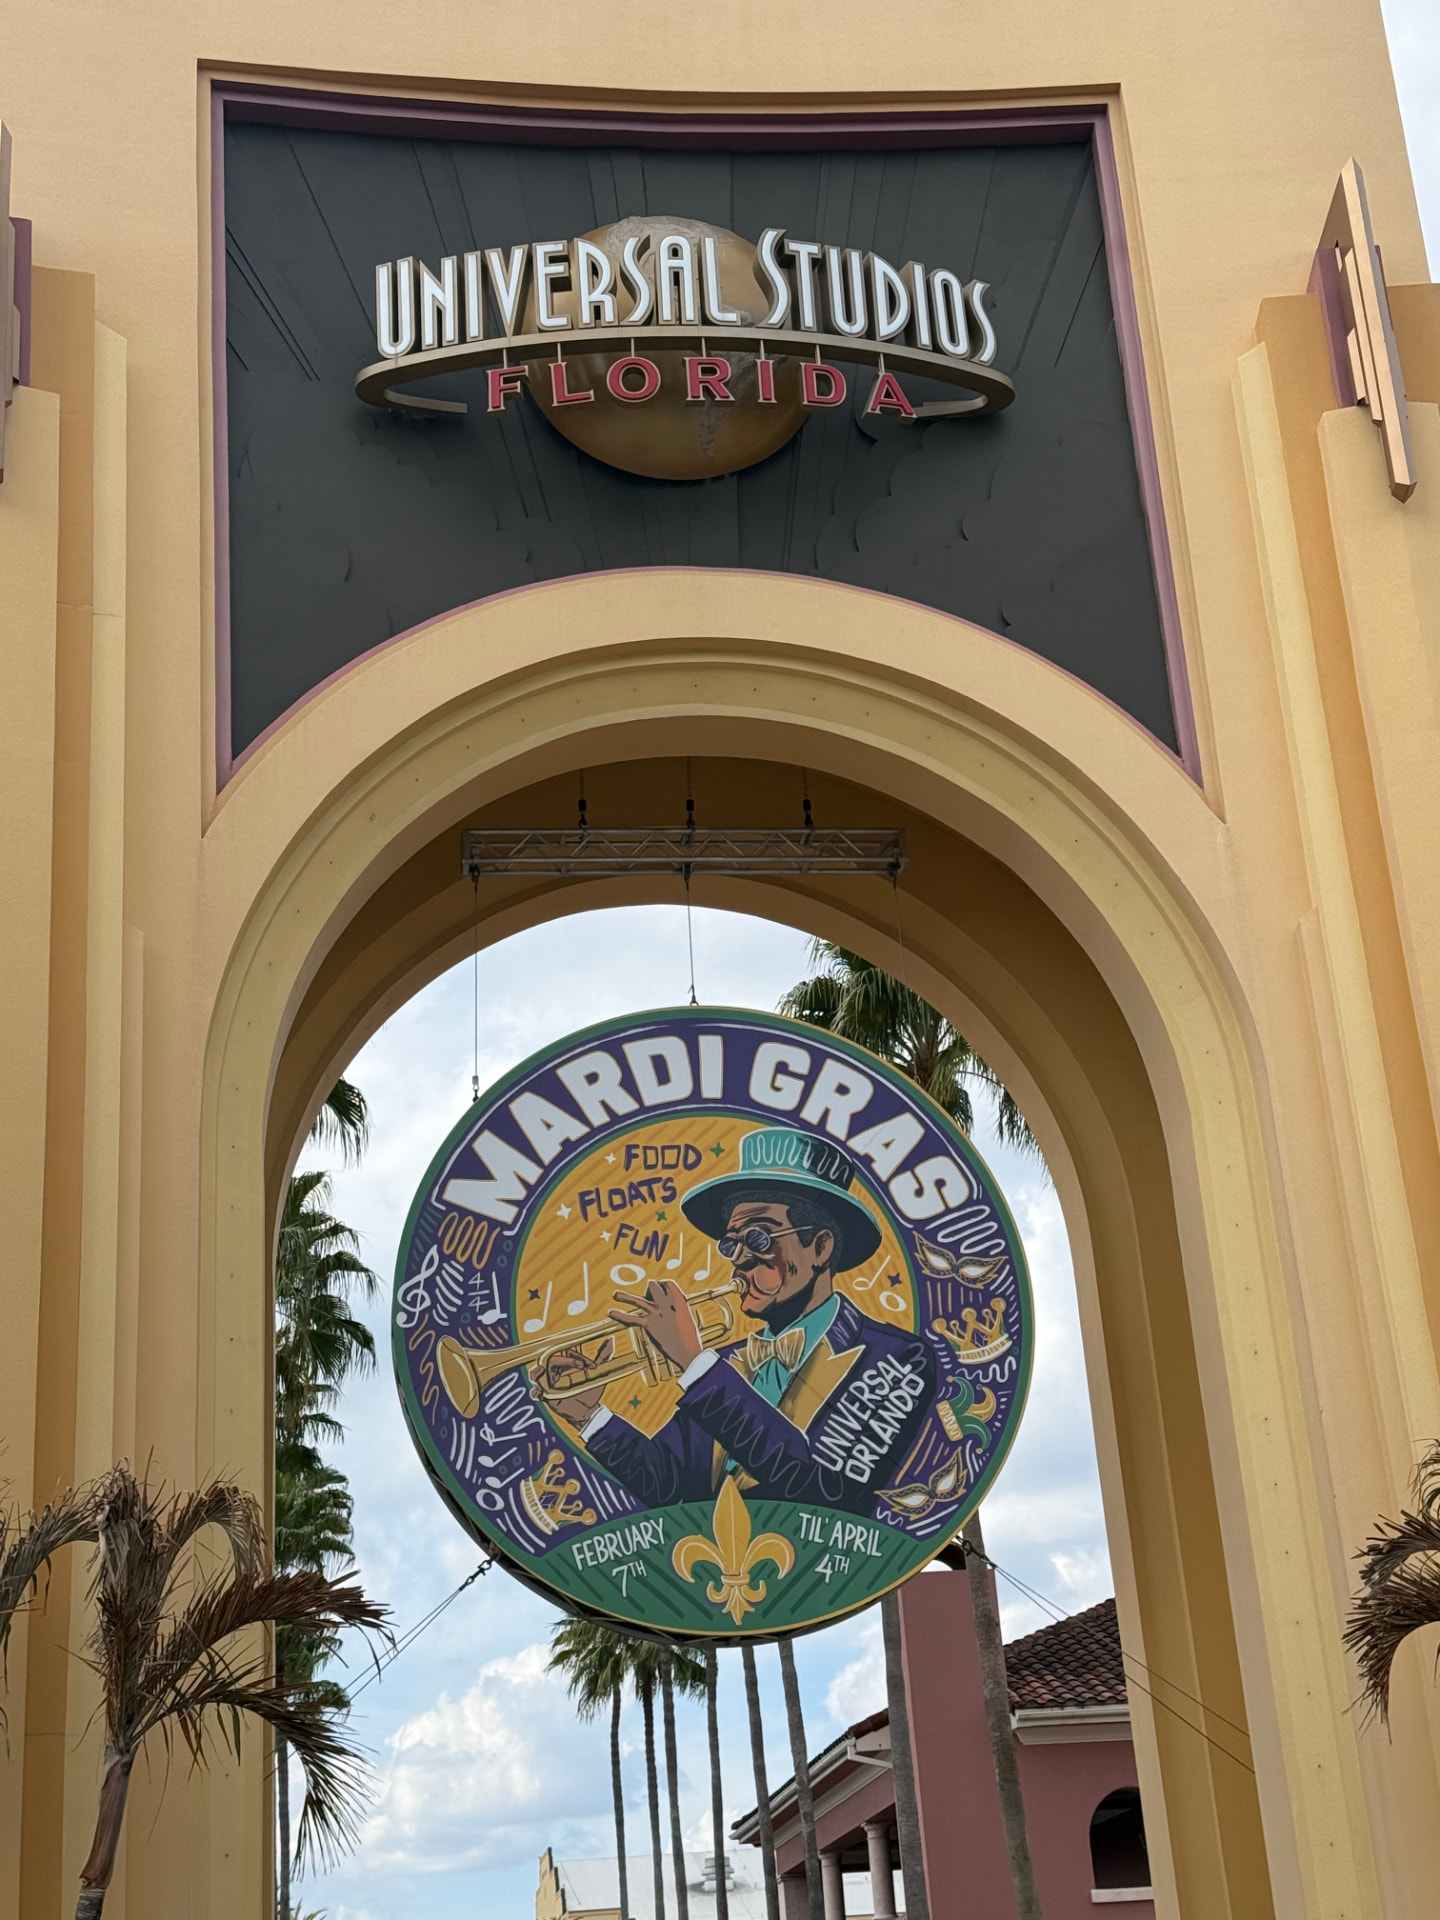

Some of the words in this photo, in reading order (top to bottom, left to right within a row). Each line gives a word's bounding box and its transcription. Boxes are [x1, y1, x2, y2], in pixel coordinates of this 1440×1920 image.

[375, 234, 740, 359] UNIVERSAL
[754, 227, 997, 366] STUDIOS
[486, 356, 918, 419] FLORIDA
[442, 1034, 724, 1225] MARDI
[749, 1041, 970, 1220] GRAS
[623, 1143, 702, 1171] FOOD
[578, 1176, 677, 1222] FLOATS
[613, 1223, 670, 1262] FUN
[811, 1353, 913, 1472] UNIVERSAL
[844, 1372, 925, 1484] ORLANDO
[571, 1517, 666, 1571] FEBRUARY
[832, 1518, 883, 1557] APRIL
[612, 1559, 647, 1597] 7TH
[815, 1553, 850, 1584] 4TH
